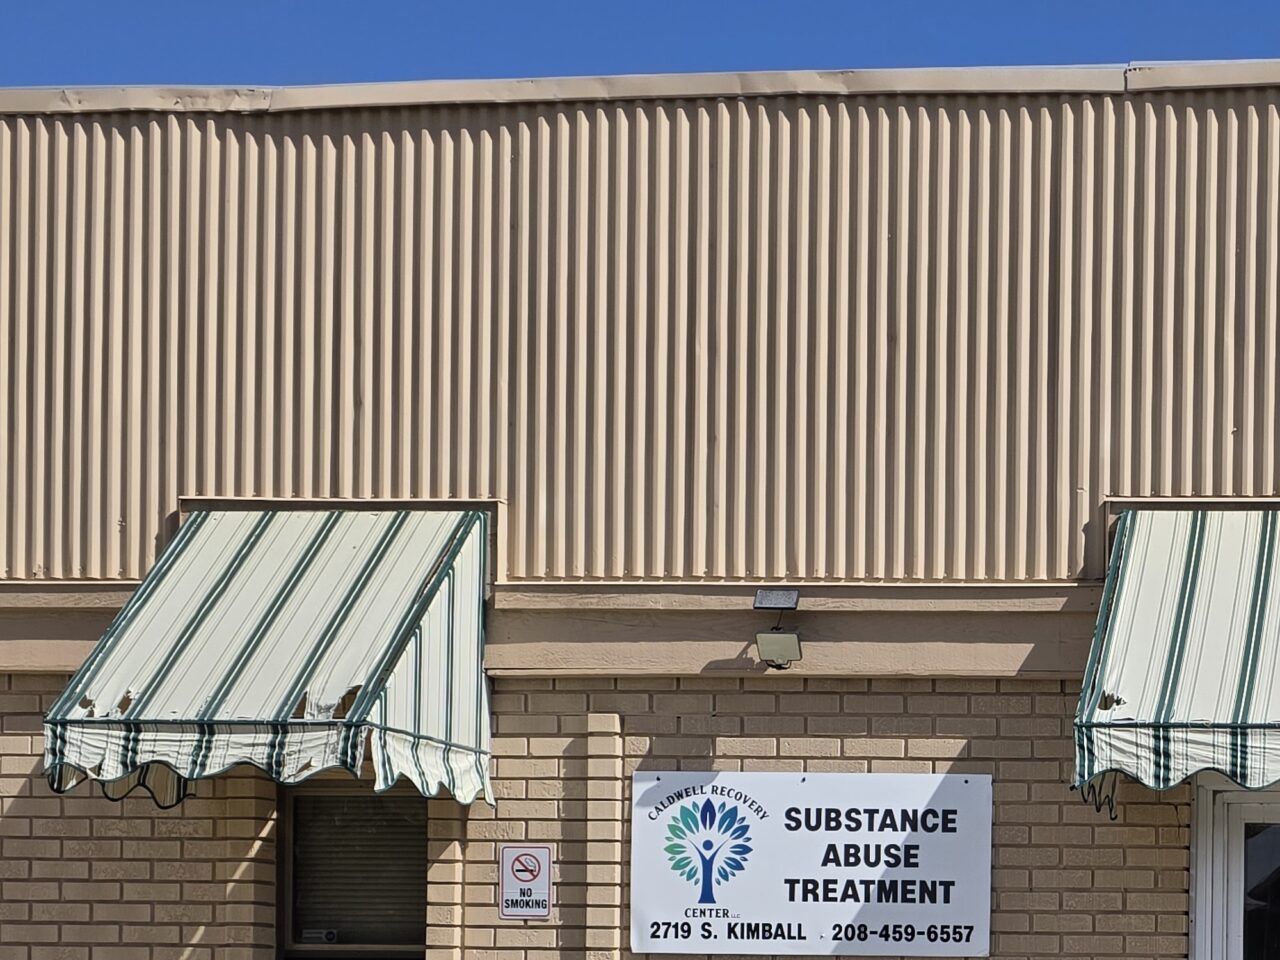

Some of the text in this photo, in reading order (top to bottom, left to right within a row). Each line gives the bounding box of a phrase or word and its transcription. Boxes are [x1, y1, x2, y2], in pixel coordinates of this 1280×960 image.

[648, 784, 770, 822] CALDWELL RECOVERY
[784, 807, 958, 833] SUBSTANCE
[821, 843, 920, 868] ABUSE
[519, 887, 533, 898] NO
[784, 878, 956, 905] TREATMENT
[504, 898, 548, 910] SMOKING
[684, 908, 730, 919] CENTER
[650, 921, 975, 943] 2719 S. KIMBALL 208-459-6557
